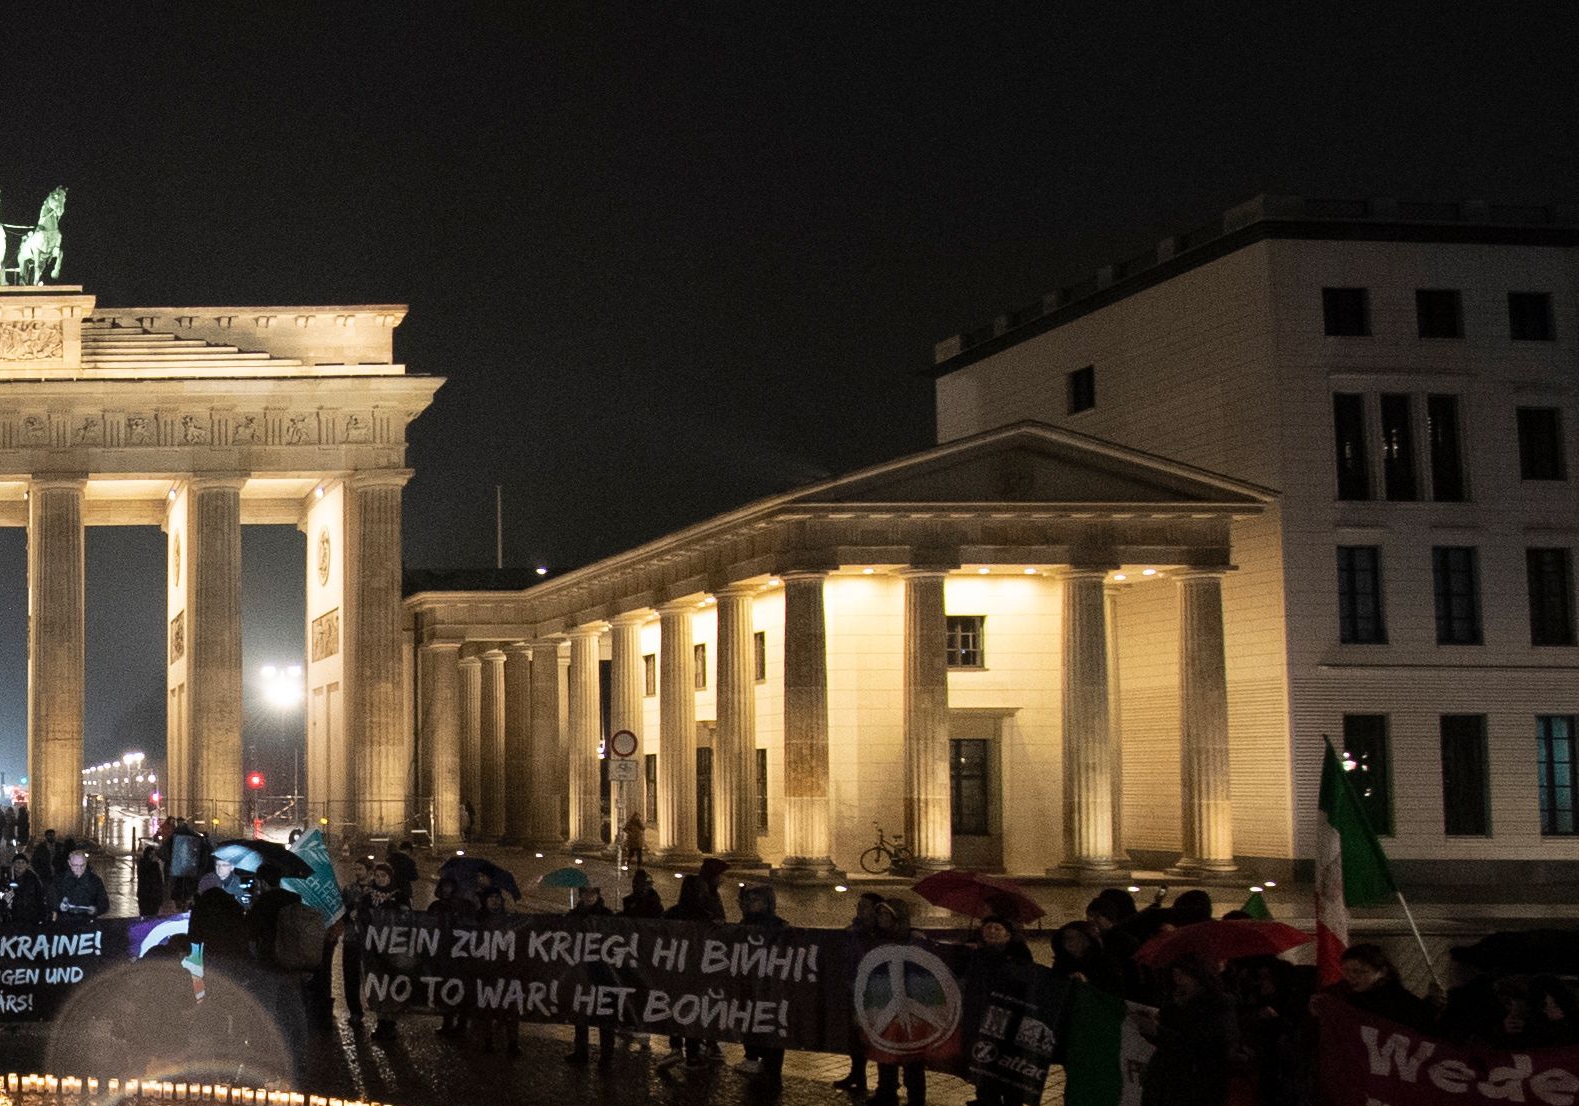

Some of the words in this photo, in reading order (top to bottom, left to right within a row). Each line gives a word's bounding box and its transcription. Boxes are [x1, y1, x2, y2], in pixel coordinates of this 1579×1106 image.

[365, 925, 441, 957] NEIN
[451, 929, 516, 962] ZUM
[528, 929, 639, 968] KRIEG!
[45, 966, 84, 984] UND
[365, 972, 413, 1002] NO
[419, 976, 465, 1008] TO
[477, 978, 559, 1017] WAR!
[643, 987, 789, 1038] ВОЙНЕ!
[997, 1054, 1047, 1081] attac
